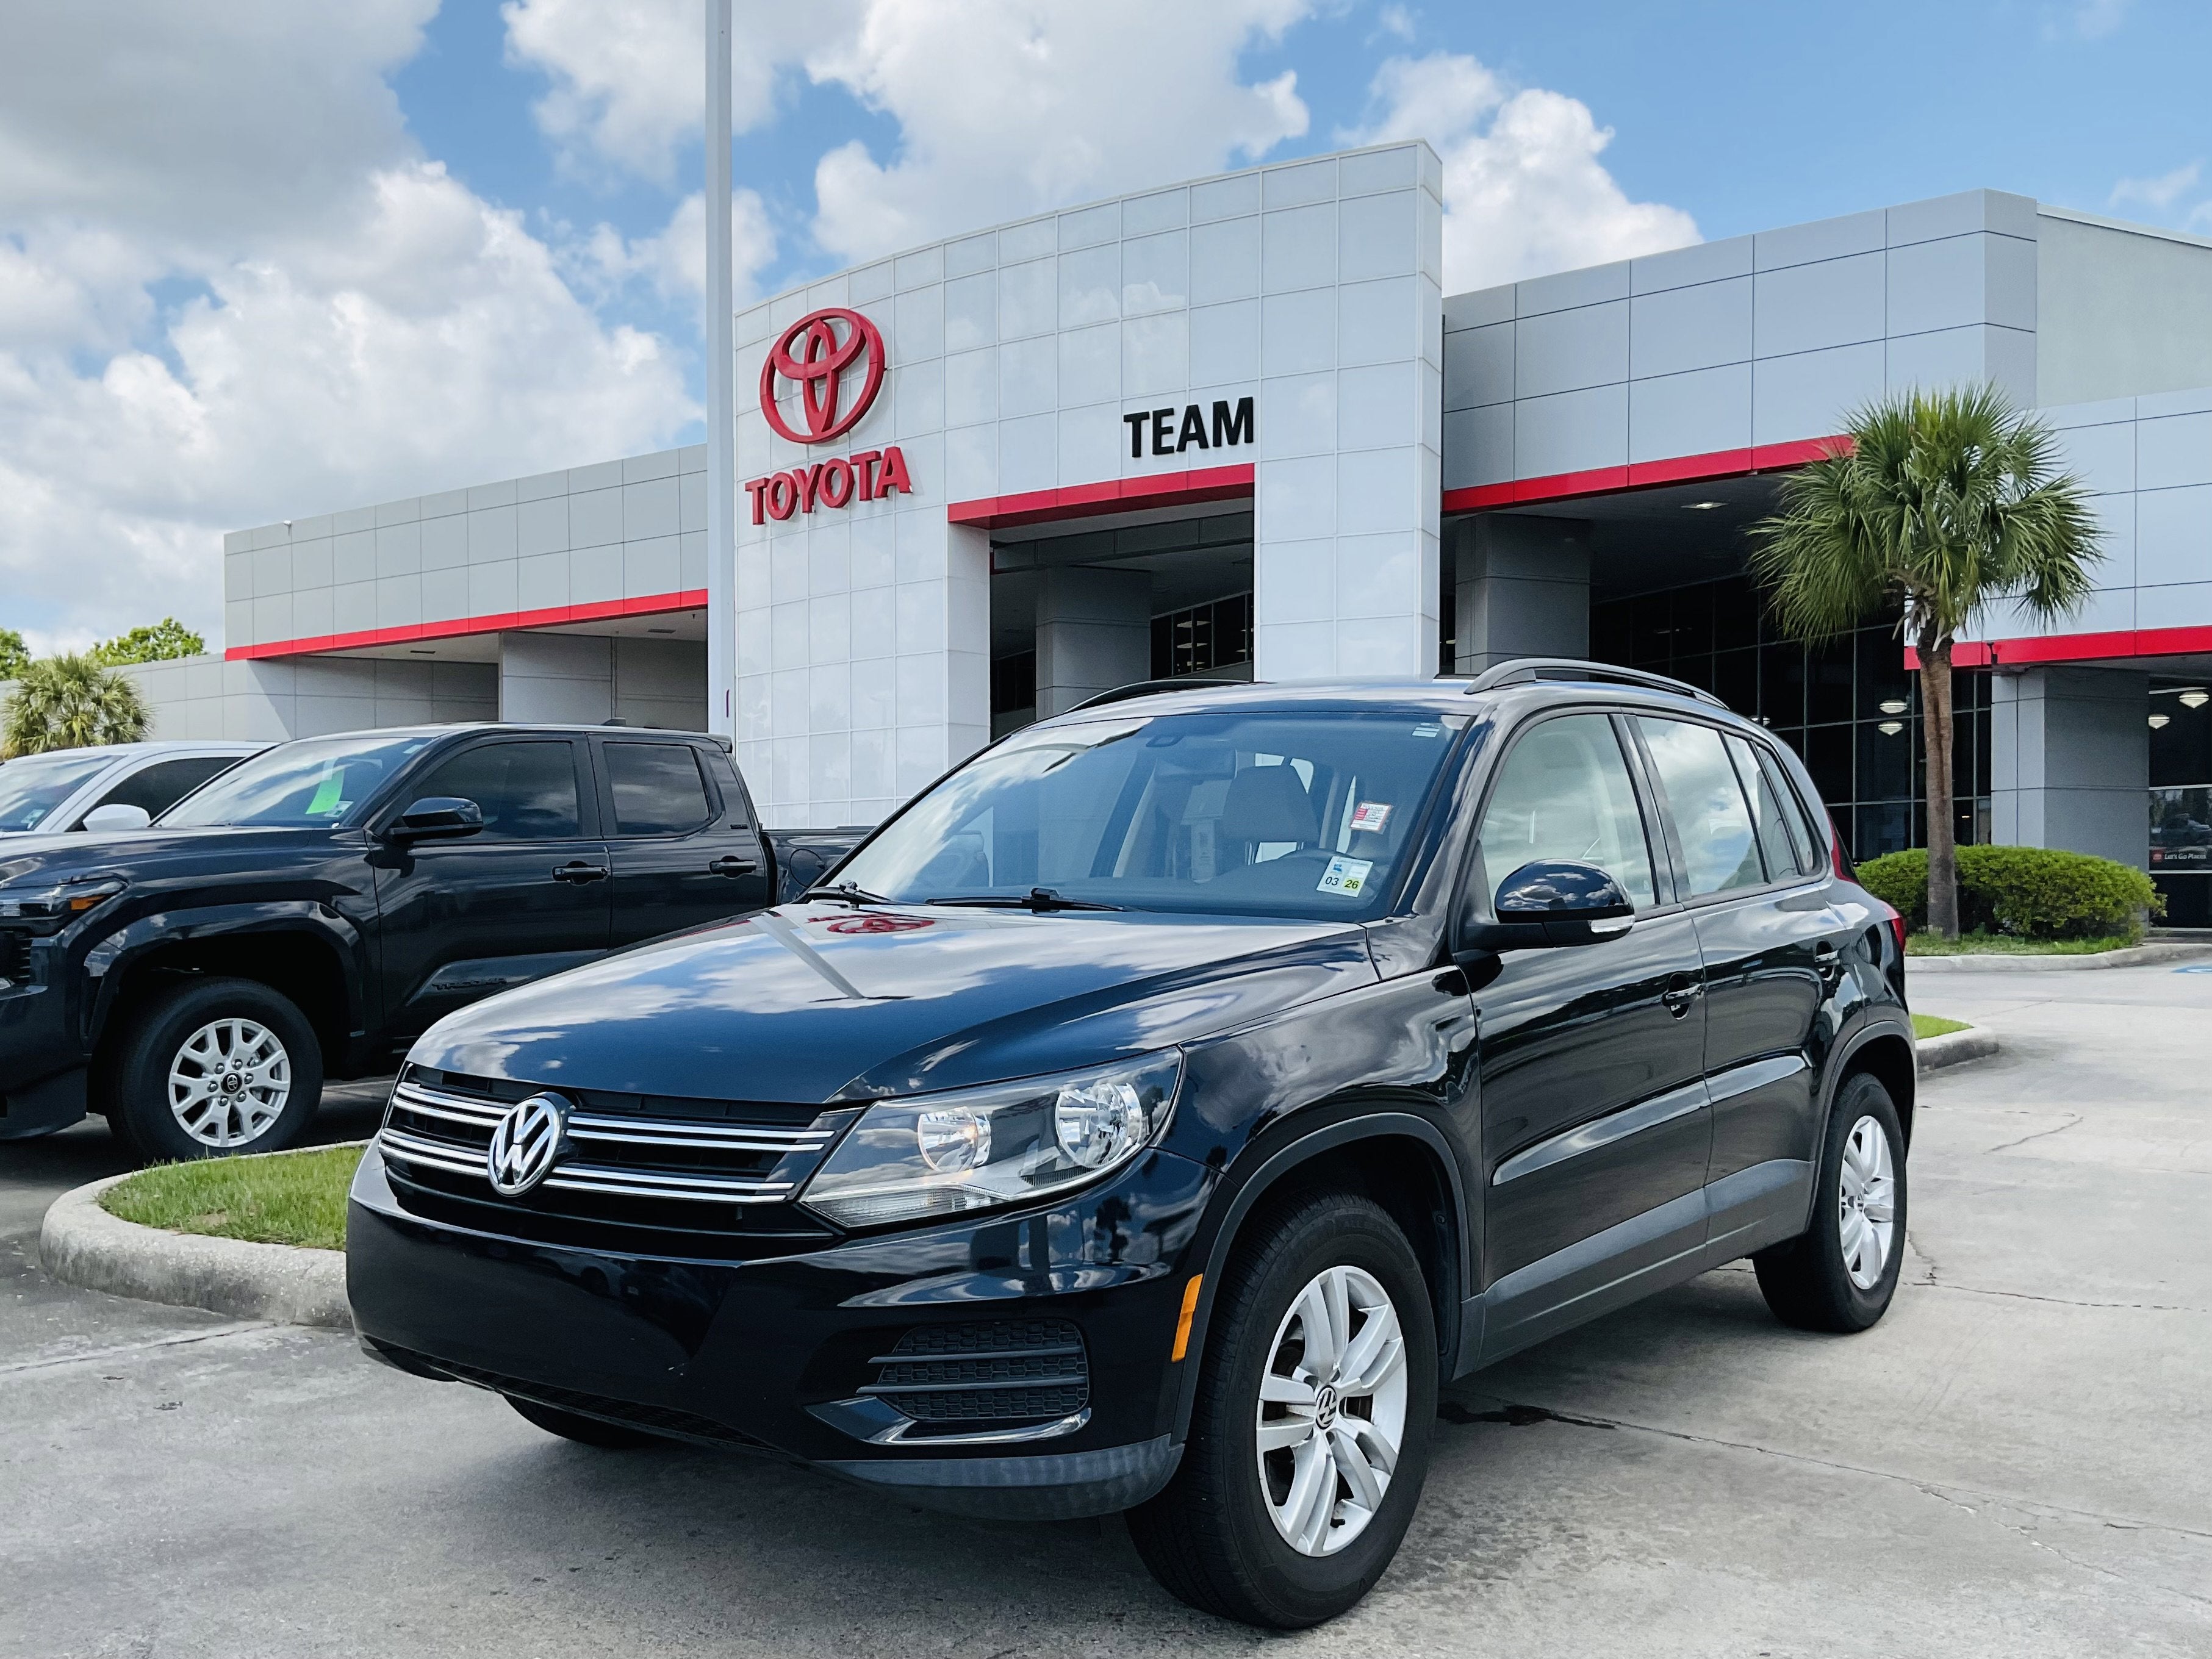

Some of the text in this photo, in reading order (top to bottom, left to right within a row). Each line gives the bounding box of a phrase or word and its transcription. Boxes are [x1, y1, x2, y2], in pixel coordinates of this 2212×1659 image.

[1124, 396, 1254, 457] TEAM
[745, 446, 912, 525] TOYOTA
[1325, 876, 1359, 889] 03 26
[489, 1096, 561, 1196] VW
